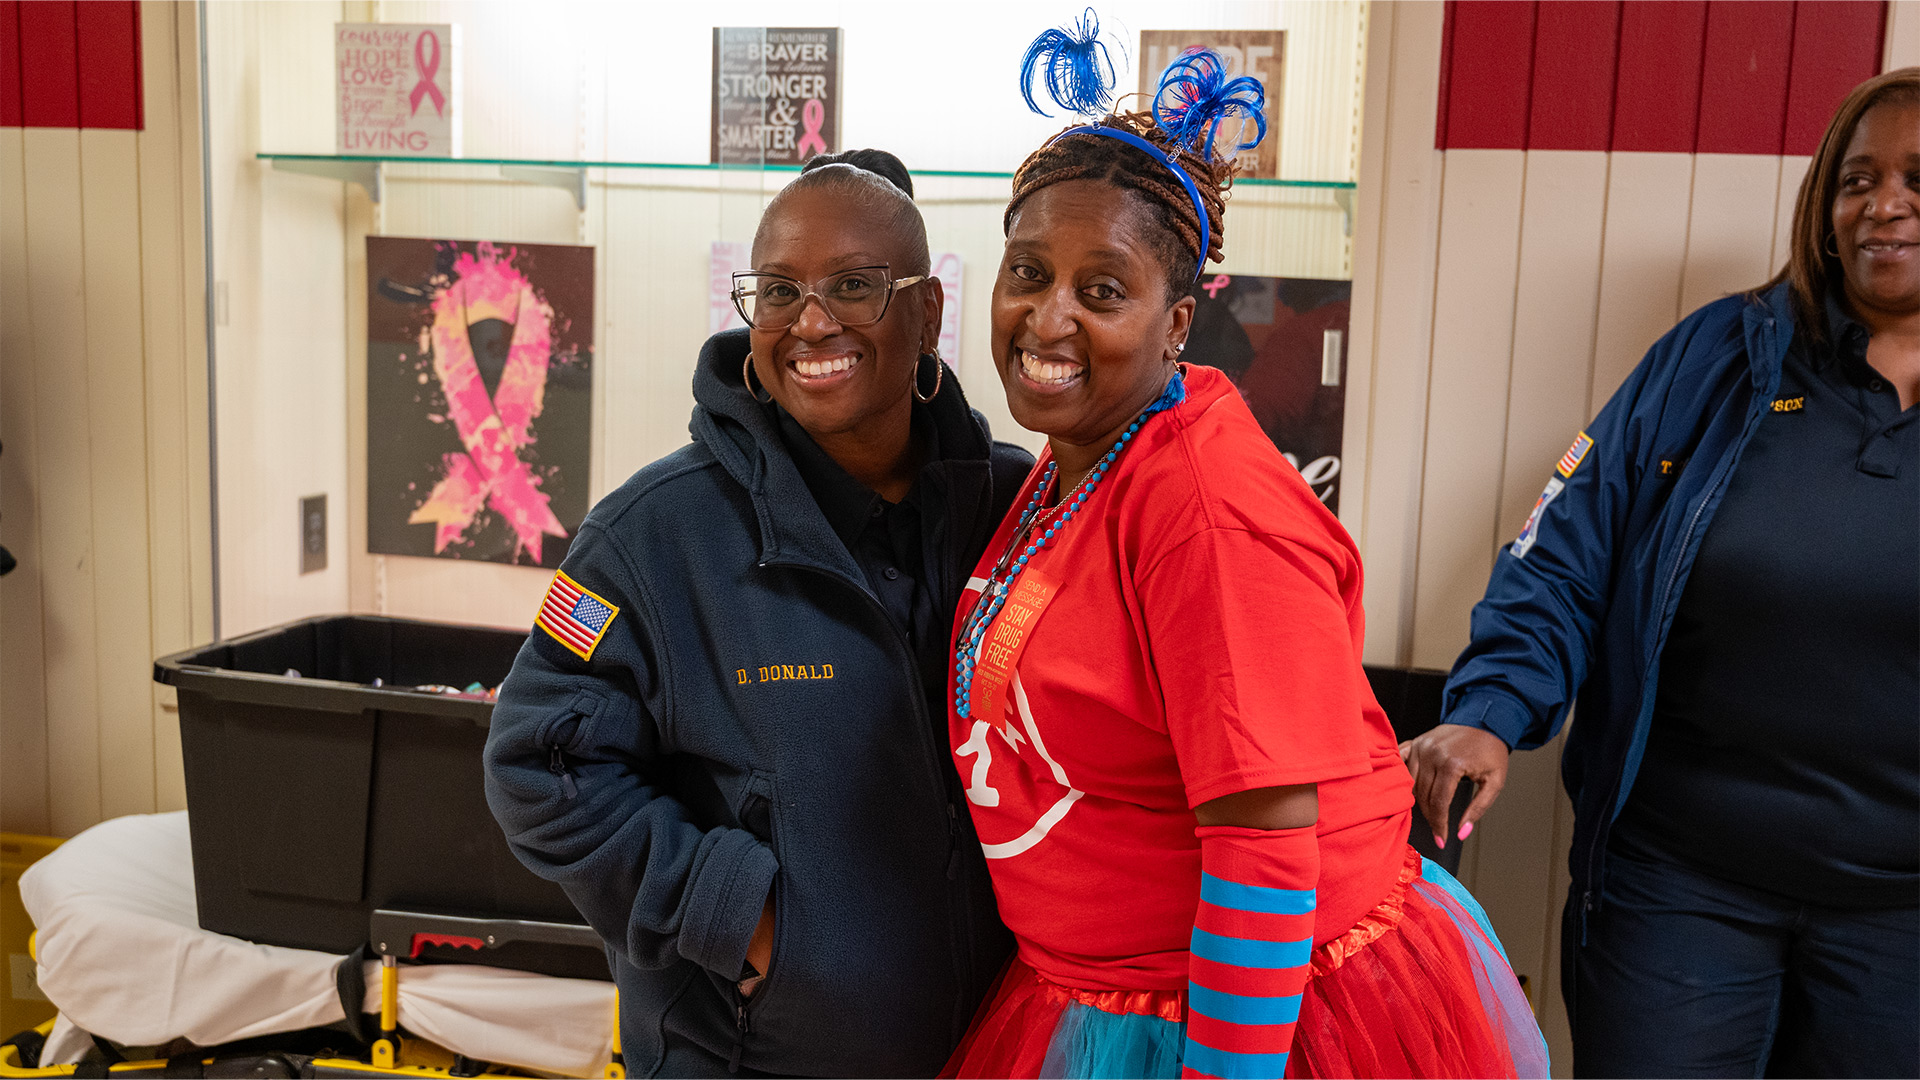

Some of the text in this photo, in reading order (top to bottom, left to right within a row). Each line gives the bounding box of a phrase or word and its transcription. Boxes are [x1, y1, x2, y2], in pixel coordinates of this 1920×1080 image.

[345, 48, 410, 69] HOPE
[747, 43, 828, 61] BRAVER
[341, 60, 394, 86] Love
[718, 74, 828, 99] STRONGER
[769, 98, 800, 126] &
[343, 130, 429, 151] LIVING
[718, 125, 796, 149] SMARTER
[1024, 579, 1047, 597] SEND A
[1005, 604, 1033, 628] STAY
[994, 622, 1023, 649] DRUG
[736, 664, 834, 684] D. DONALD
